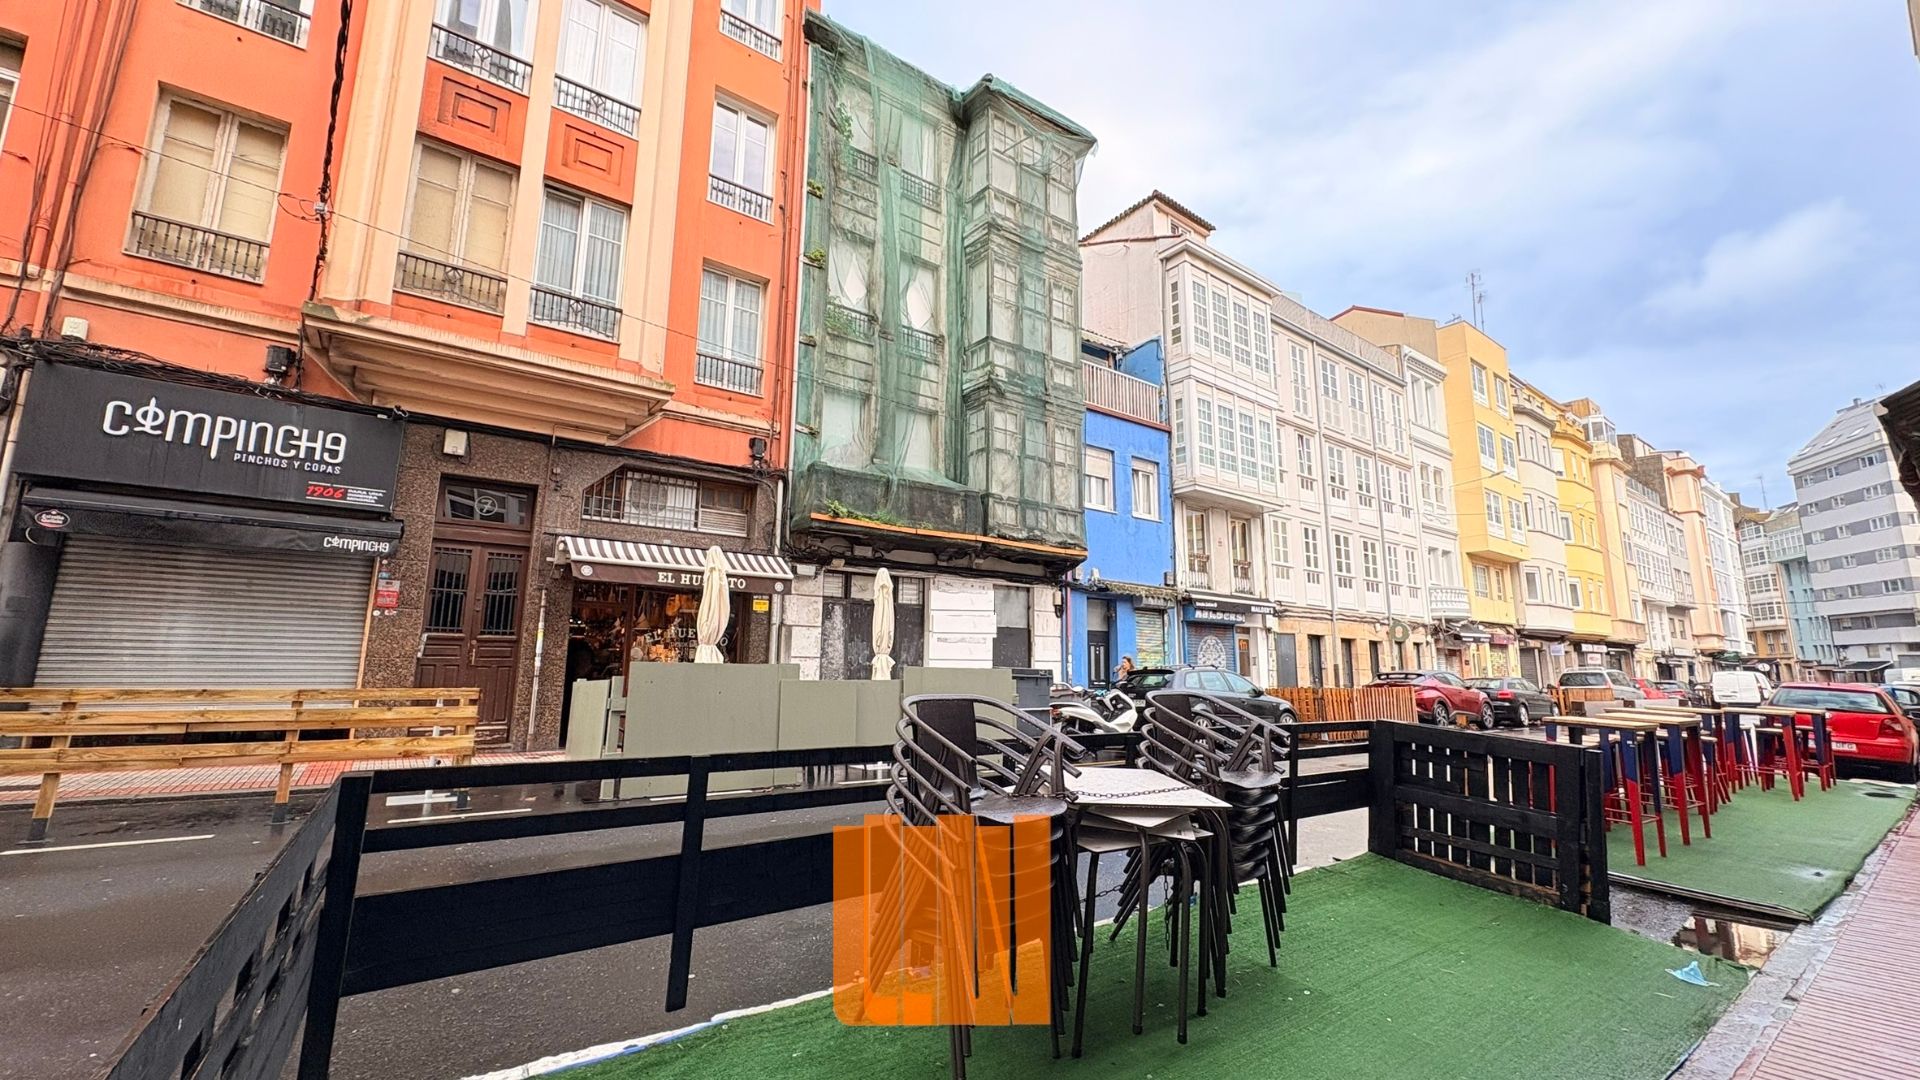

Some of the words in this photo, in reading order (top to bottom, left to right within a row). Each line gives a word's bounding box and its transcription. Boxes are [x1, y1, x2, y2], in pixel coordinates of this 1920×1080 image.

[233, 452, 288, 469] PINCHOS
[293, 461, 301, 470] Y
[304, 462, 341, 475] COPAS
[306, 485, 345, 499] 1906
[657, 571, 675, 584] EL
[680, 573, 746, 589] HUTO
